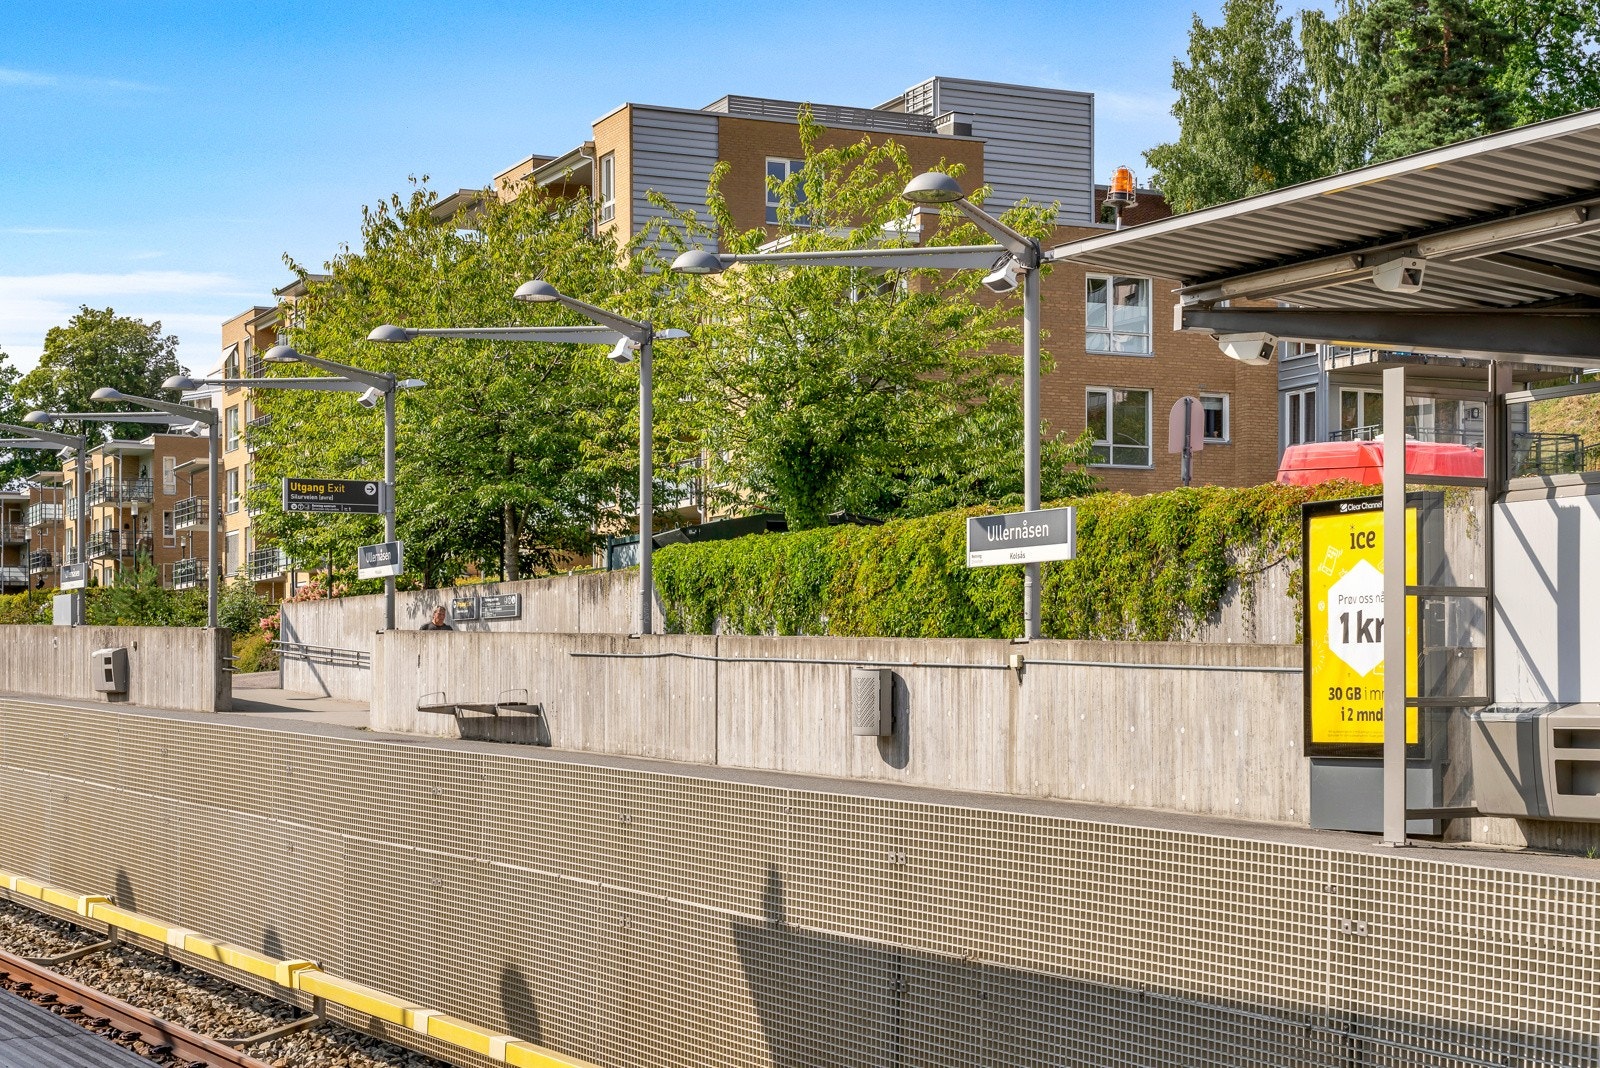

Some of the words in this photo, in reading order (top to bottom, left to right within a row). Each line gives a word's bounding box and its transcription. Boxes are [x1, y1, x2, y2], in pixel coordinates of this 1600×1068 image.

[290, 482, 325, 494] Utgang
[327, 483, 345, 493] Exit
[1362, 501, 1382, 510] Channel
[987, 520, 1049, 542] Ullernåsen
[1350, 525, 1376, 550] ice
[1010, 552, 1026, 560] Kolsås
[1338, 594, 1357, 604] Prøv
[1359, 595, 1374, 604] oss
[1340, 611, 1349, 644] 1
[1356, 610, 1384, 643] kr
[1328, 687, 1342, 701] 30
[1346, 687, 1362, 700] GB
[1341, 707, 1344, 722] i
[1348, 708, 1354, 721] 2
